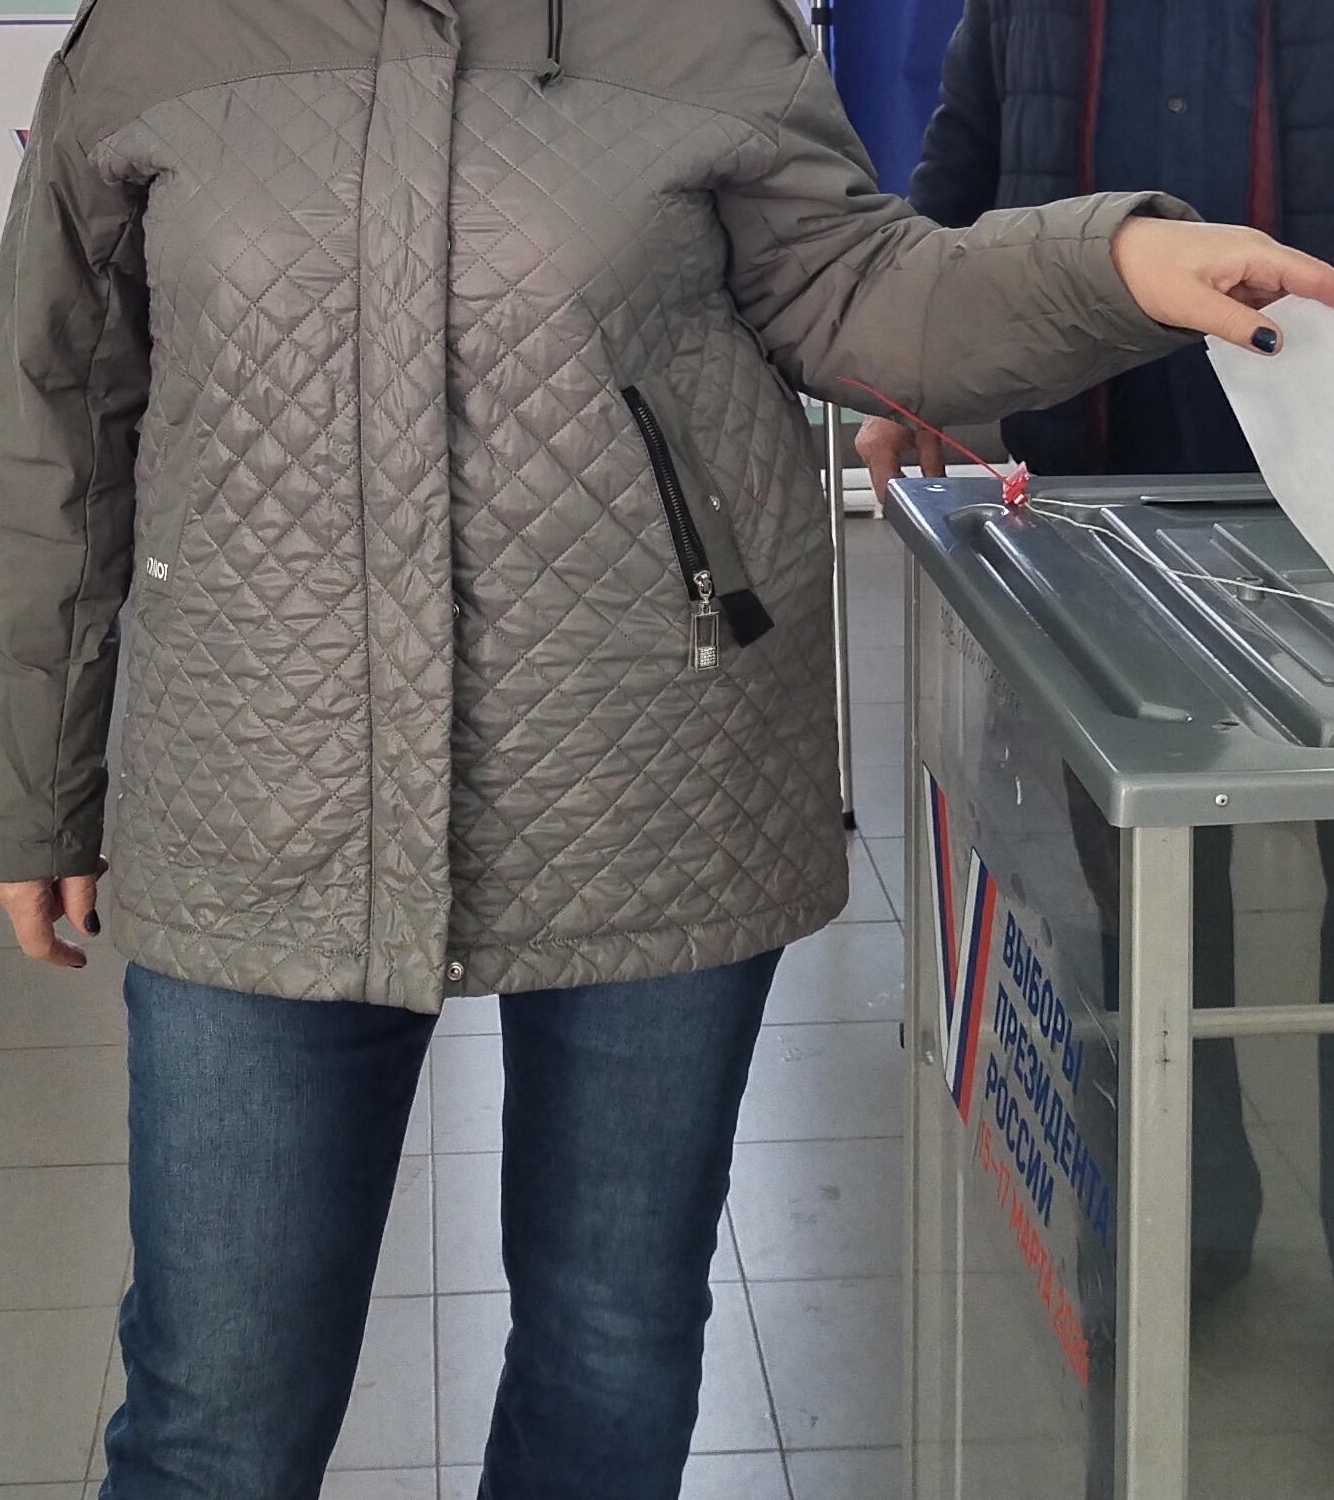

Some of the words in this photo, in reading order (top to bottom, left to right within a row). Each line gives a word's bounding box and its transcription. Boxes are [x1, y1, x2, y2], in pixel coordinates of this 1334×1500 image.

[1002, 909, 1085, 1096] ВЫБОРЫ
[984, 1051, 1055, 1229] РОССИИ
[994, 982, 1113, 1250] ПРЕЗИДЕНТА
